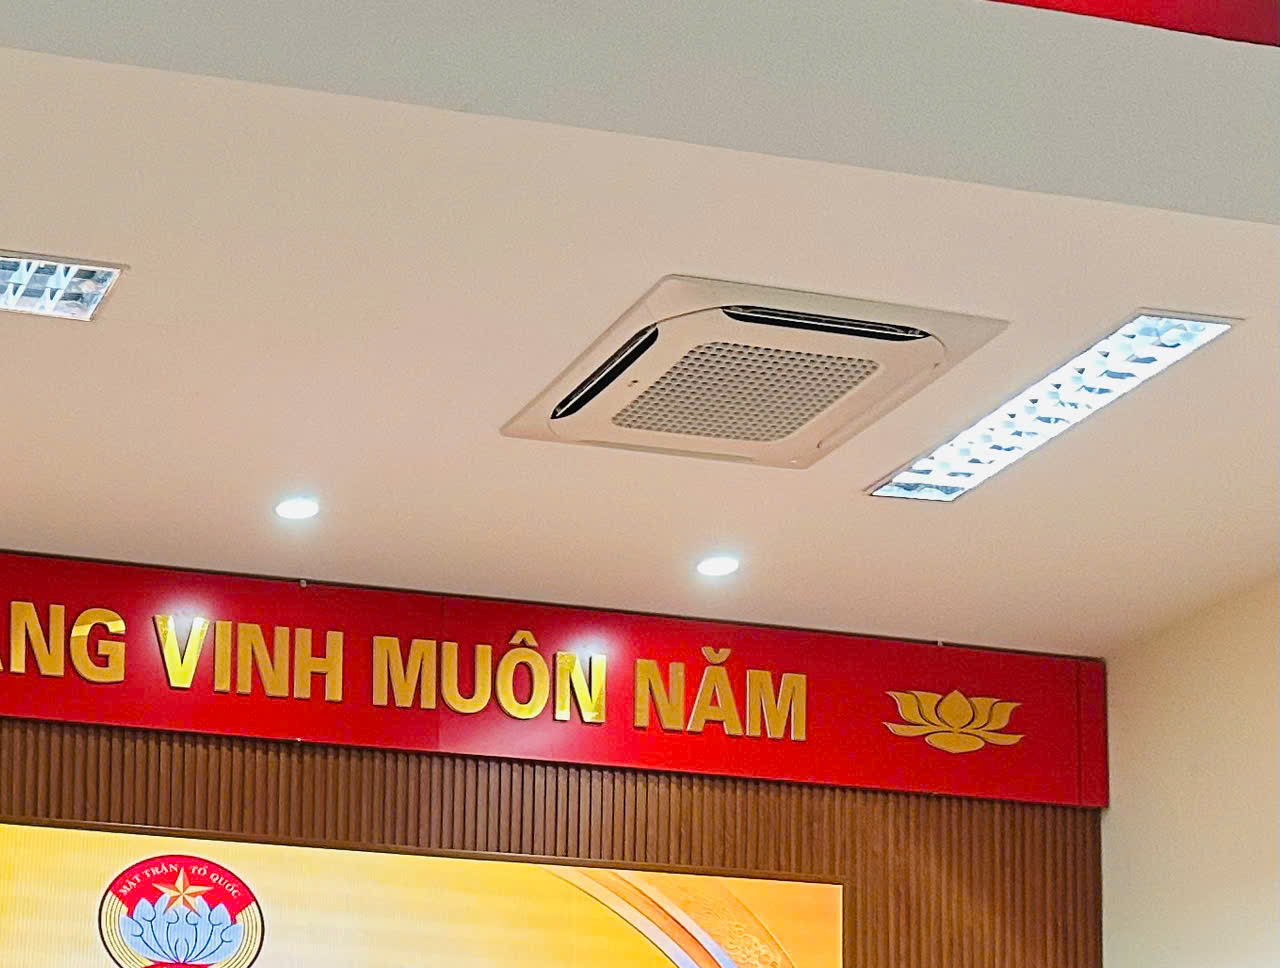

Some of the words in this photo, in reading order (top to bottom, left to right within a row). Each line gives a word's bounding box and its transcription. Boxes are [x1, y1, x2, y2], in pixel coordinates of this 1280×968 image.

[152, 614, 344, 703] VINH
[371, 629, 608, 725] MUÔN
[634, 646, 808, 742] NĂM
